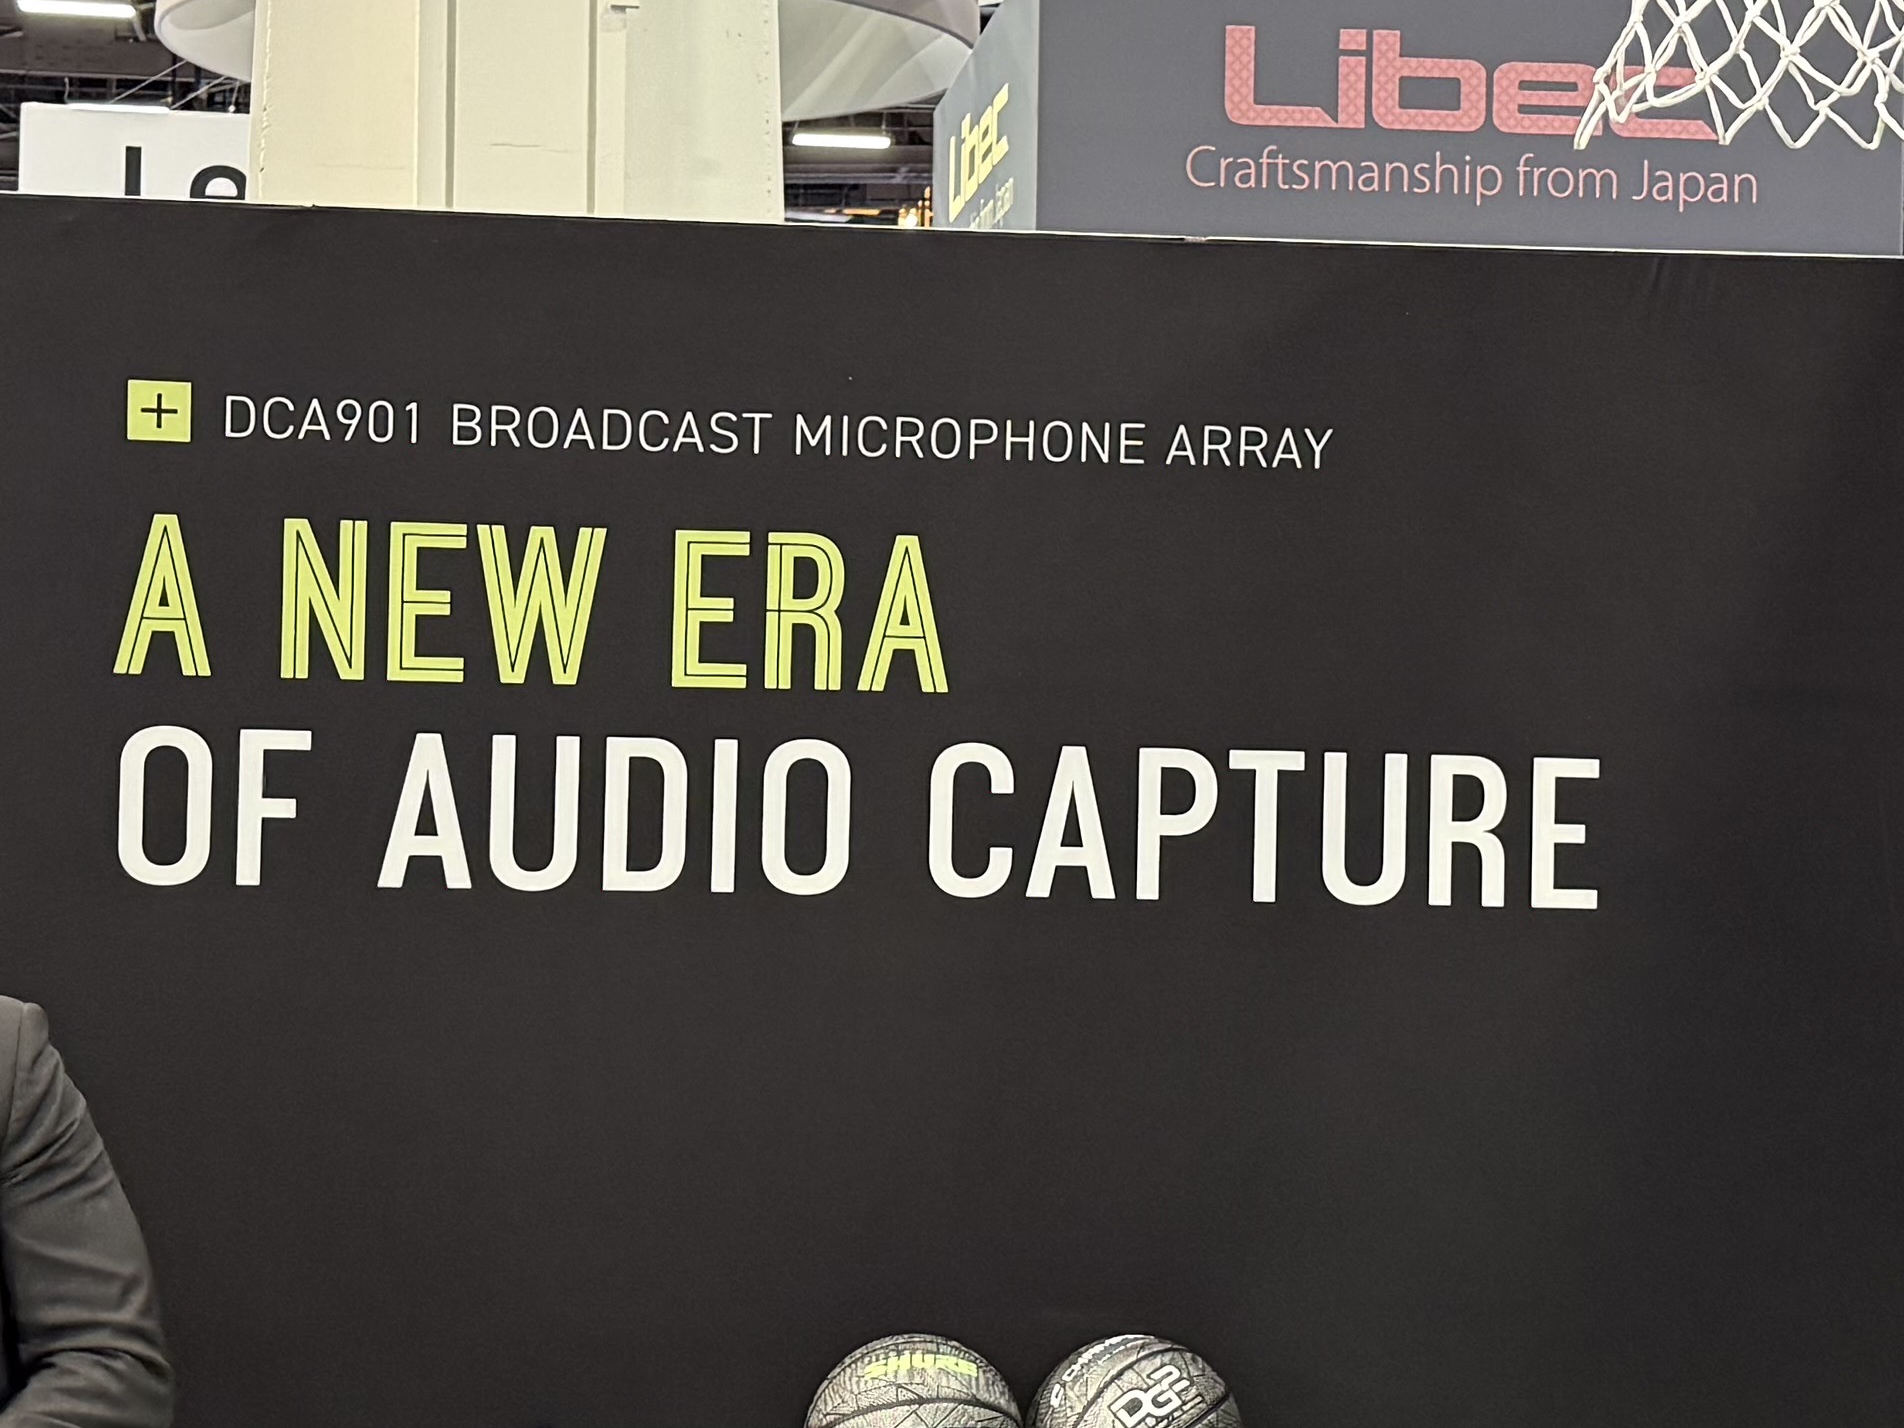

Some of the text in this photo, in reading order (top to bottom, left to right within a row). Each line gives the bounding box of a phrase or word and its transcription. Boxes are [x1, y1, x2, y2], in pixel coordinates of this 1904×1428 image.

[1226, 24, 1718, 142] Libec
[1186, 145, 1759, 212] Craftsmanship from Japan
[224, 394, 1336, 471] DCA901 BROADCAST MICROPHONE ARRAY
[114, 513, 951, 694] A NEW ERA
[116, 723, 1602, 911] OF AUDIO CAPTURE
[863, 1350, 979, 1380] SHURE
